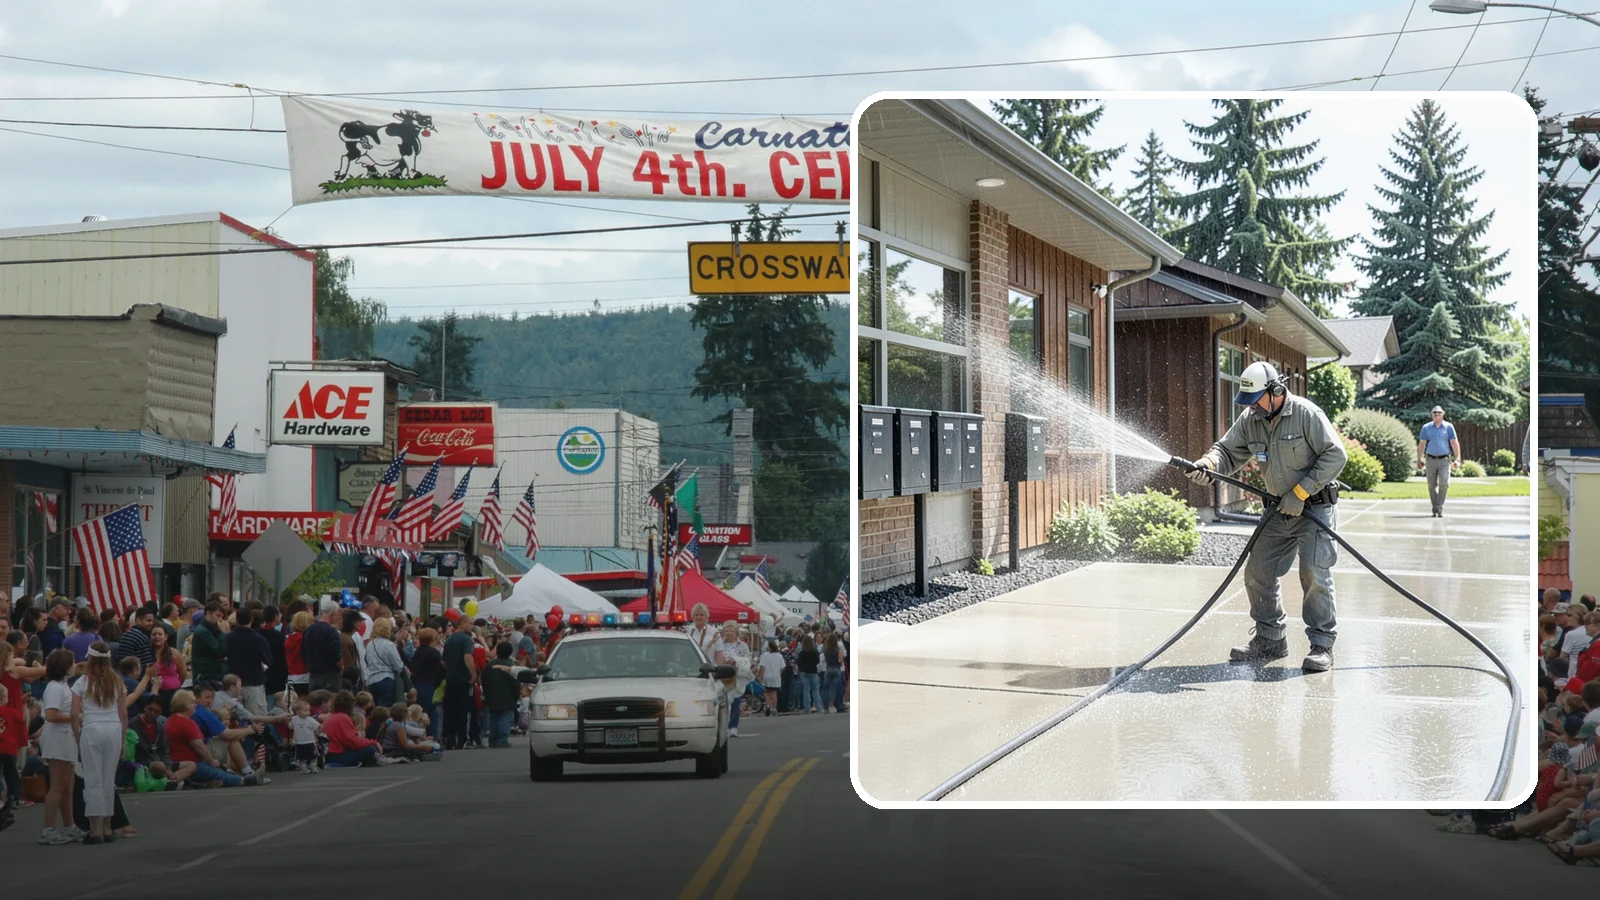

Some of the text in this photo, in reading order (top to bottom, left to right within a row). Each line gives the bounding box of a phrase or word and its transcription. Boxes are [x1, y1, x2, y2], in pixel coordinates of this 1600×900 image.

[481, 141, 605, 192] JULY
[632, 150, 746, 197] 4th.
[696, 254, 850, 280] CROSSWA
[282, 380, 373, 420] ACE
[406, 410, 485, 422] CEDAR LOG
[283, 421, 370, 437] Hardware
[416, 428, 476, 447] Coca-Cola
[353, 467, 386, 480] Simpl
[83, 485, 155, 495] St. Vincent de Paul
[688, 526, 742, 535] CRNATION
[699, 535, 730, 543] GLASS
